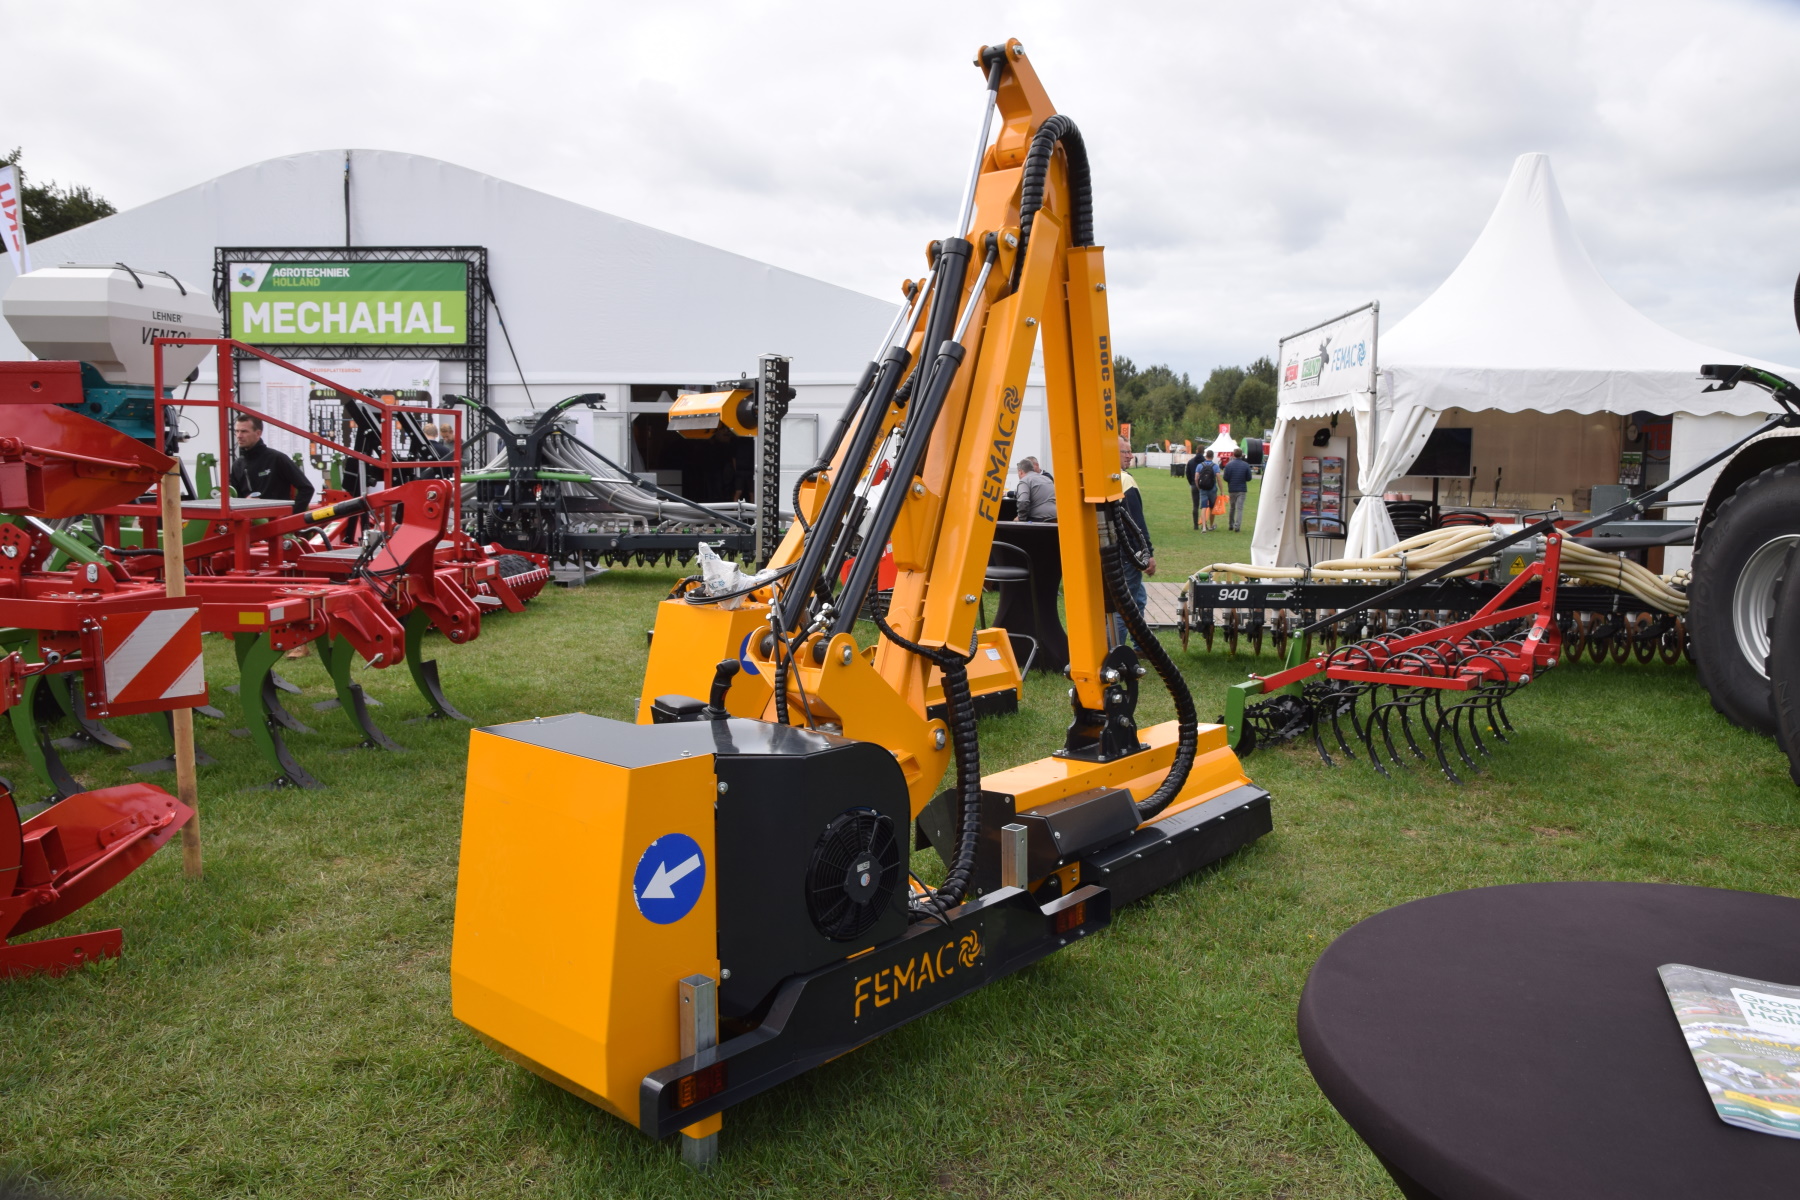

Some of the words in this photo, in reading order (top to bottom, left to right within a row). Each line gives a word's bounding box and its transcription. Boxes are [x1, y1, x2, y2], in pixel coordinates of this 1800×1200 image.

[272, 267, 350, 278] AGROTECHNIEK
[272, 277, 321, 287] HOLLAND
[242, 301, 456, 334] MECHAHAL
[1098, 335, 1110, 382] DOC
[1331, 344, 1357, 372] FEMAC
[1103, 387, 1114, 432] 302
[978, 413, 1015, 522] FEMAC
[1218, 588, 1249, 601] 940
[855, 941, 955, 1018] FEMAC
[1738, 993, 1800, 1011] Groe
